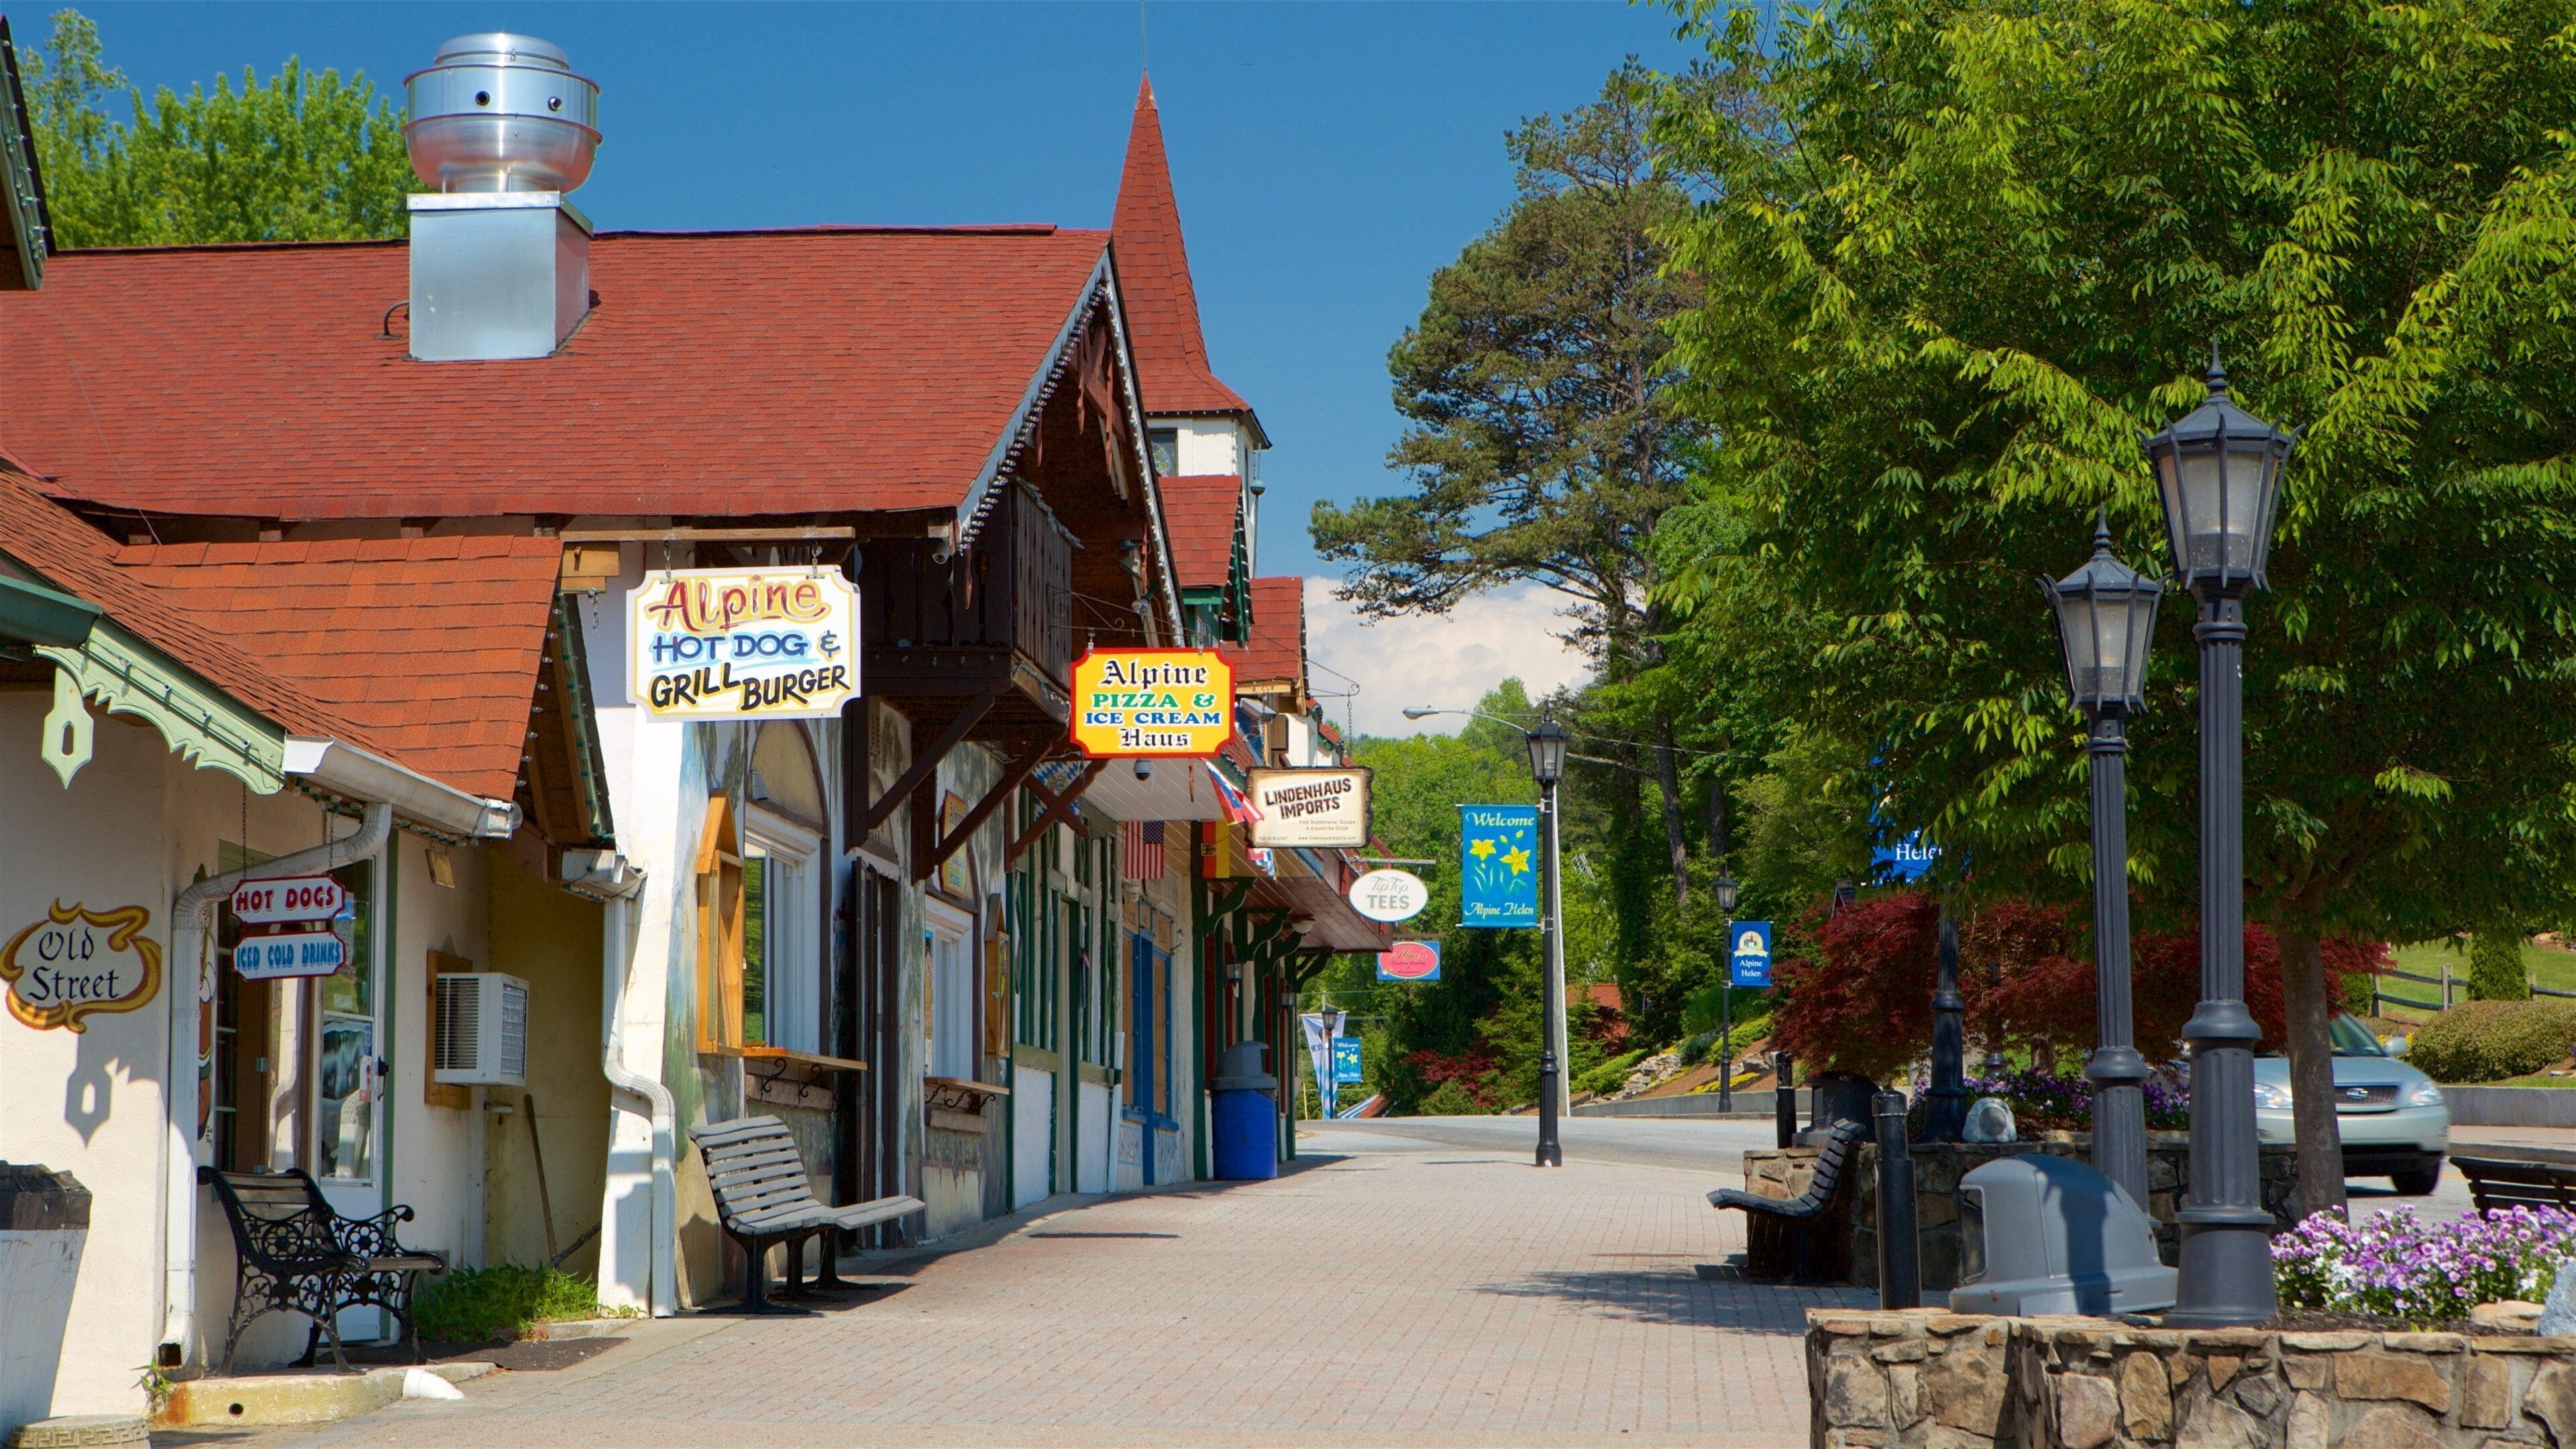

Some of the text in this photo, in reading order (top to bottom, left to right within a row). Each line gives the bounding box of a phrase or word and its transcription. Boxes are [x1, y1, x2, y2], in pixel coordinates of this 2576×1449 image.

[648, 575, 826, 633] Alpine
[653, 630, 841, 663] HOT DOG &
[1100, 659, 1208, 690] Alpine
[651, 662, 851, 711] GRILL BURGER
[1092, 693, 1215, 708] PIZZA &
[1085, 712, 1221, 724] ICE CREAM
[1119, 728, 1189, 747] Haus
[1265, 778, 1352, 806] LINDENHAUS
[1280, 796, 1340, 819] IMPORTS
[1465, 812, 1535, 826] Welcome
[1371, 876, 1409, 894] Tip Top
[236, 885, 335, 913] HOT DOGS
[1366, 895, 1410, 909] TEES
[1464, 902, 1534, 919] Alpine Helen
[38, 926, 95, 961] Old
[236, 941, 341, 970] ICED COLD DRINKS
[1739, 959, 1763, 968] Alpine
[27, 966, 119, 1000] Street
[1741, 969, 1762, 977] Helen
